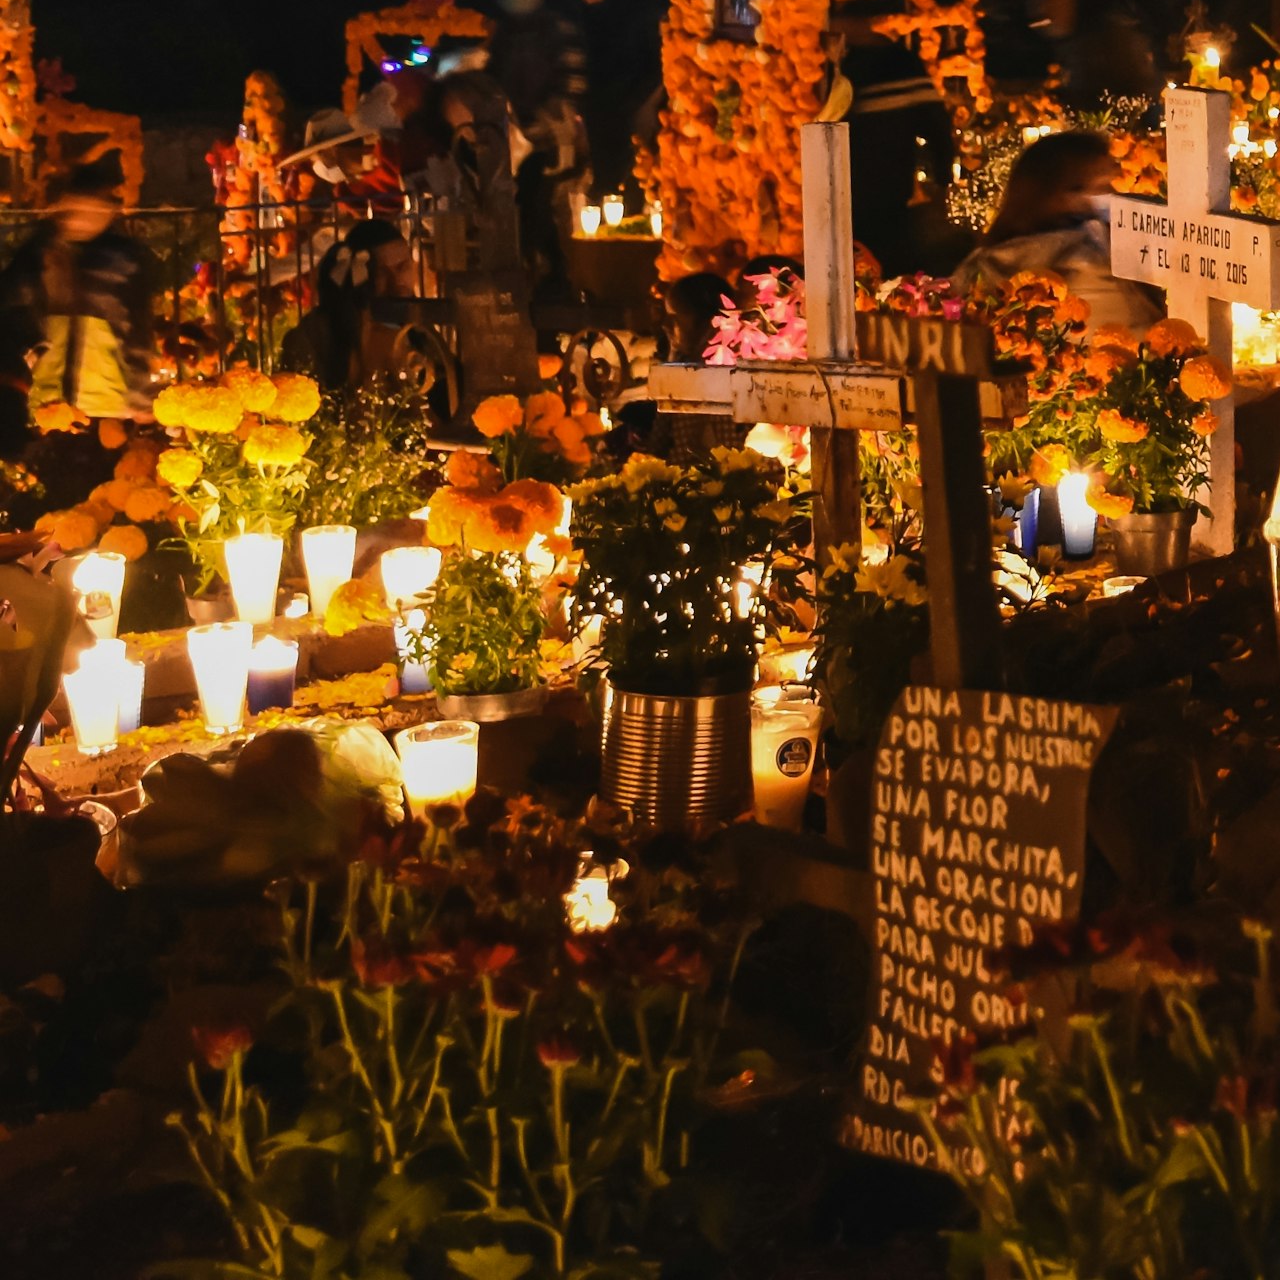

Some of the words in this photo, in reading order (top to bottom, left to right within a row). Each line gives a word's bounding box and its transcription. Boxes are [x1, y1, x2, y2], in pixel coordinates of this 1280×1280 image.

[1118, 210, 1126, 228] J.
[1132, 211, 1175, 239] CARMEN
[1182, 221, 1231, 250] APARICIO
[1252, 236, 1262, 257] P.
[1158, 248, 1170, 269] EL
[1181, 253, 1190, 273] 13
[1226, 262, 1248, 285] 2015
[867, 314, 967, 376] INRI
[903, 686, 962, 718] UNA
[983, 691, 1100, 738] LAGRIMA
[890, 714, 940, 752] POR
[952, 723, 998, 761] LOS
[1005, 731, 1094, 769] NUESTROS
[876, 748, 905, 781] SE
[921, 753, 1050, 803] EVAPORA,
[876, 781, 931, 819] UNA
[945, 789, 1008, 831] FLOR
[873, 813, 901, 847] SE
[922, 821, 1078, 890] MARCHITA,
[873, 846, 926, 888] UNA
[936, 866, 1063, 920] ORACION
[876, 880, 907, 919] LA
[913, 894, 1005, 948] RECOJE
[876, 917, 936, 966] PARA
[881, 953, 956, 1012] PICHO
[868, 1024, 911, 1065] DIA
